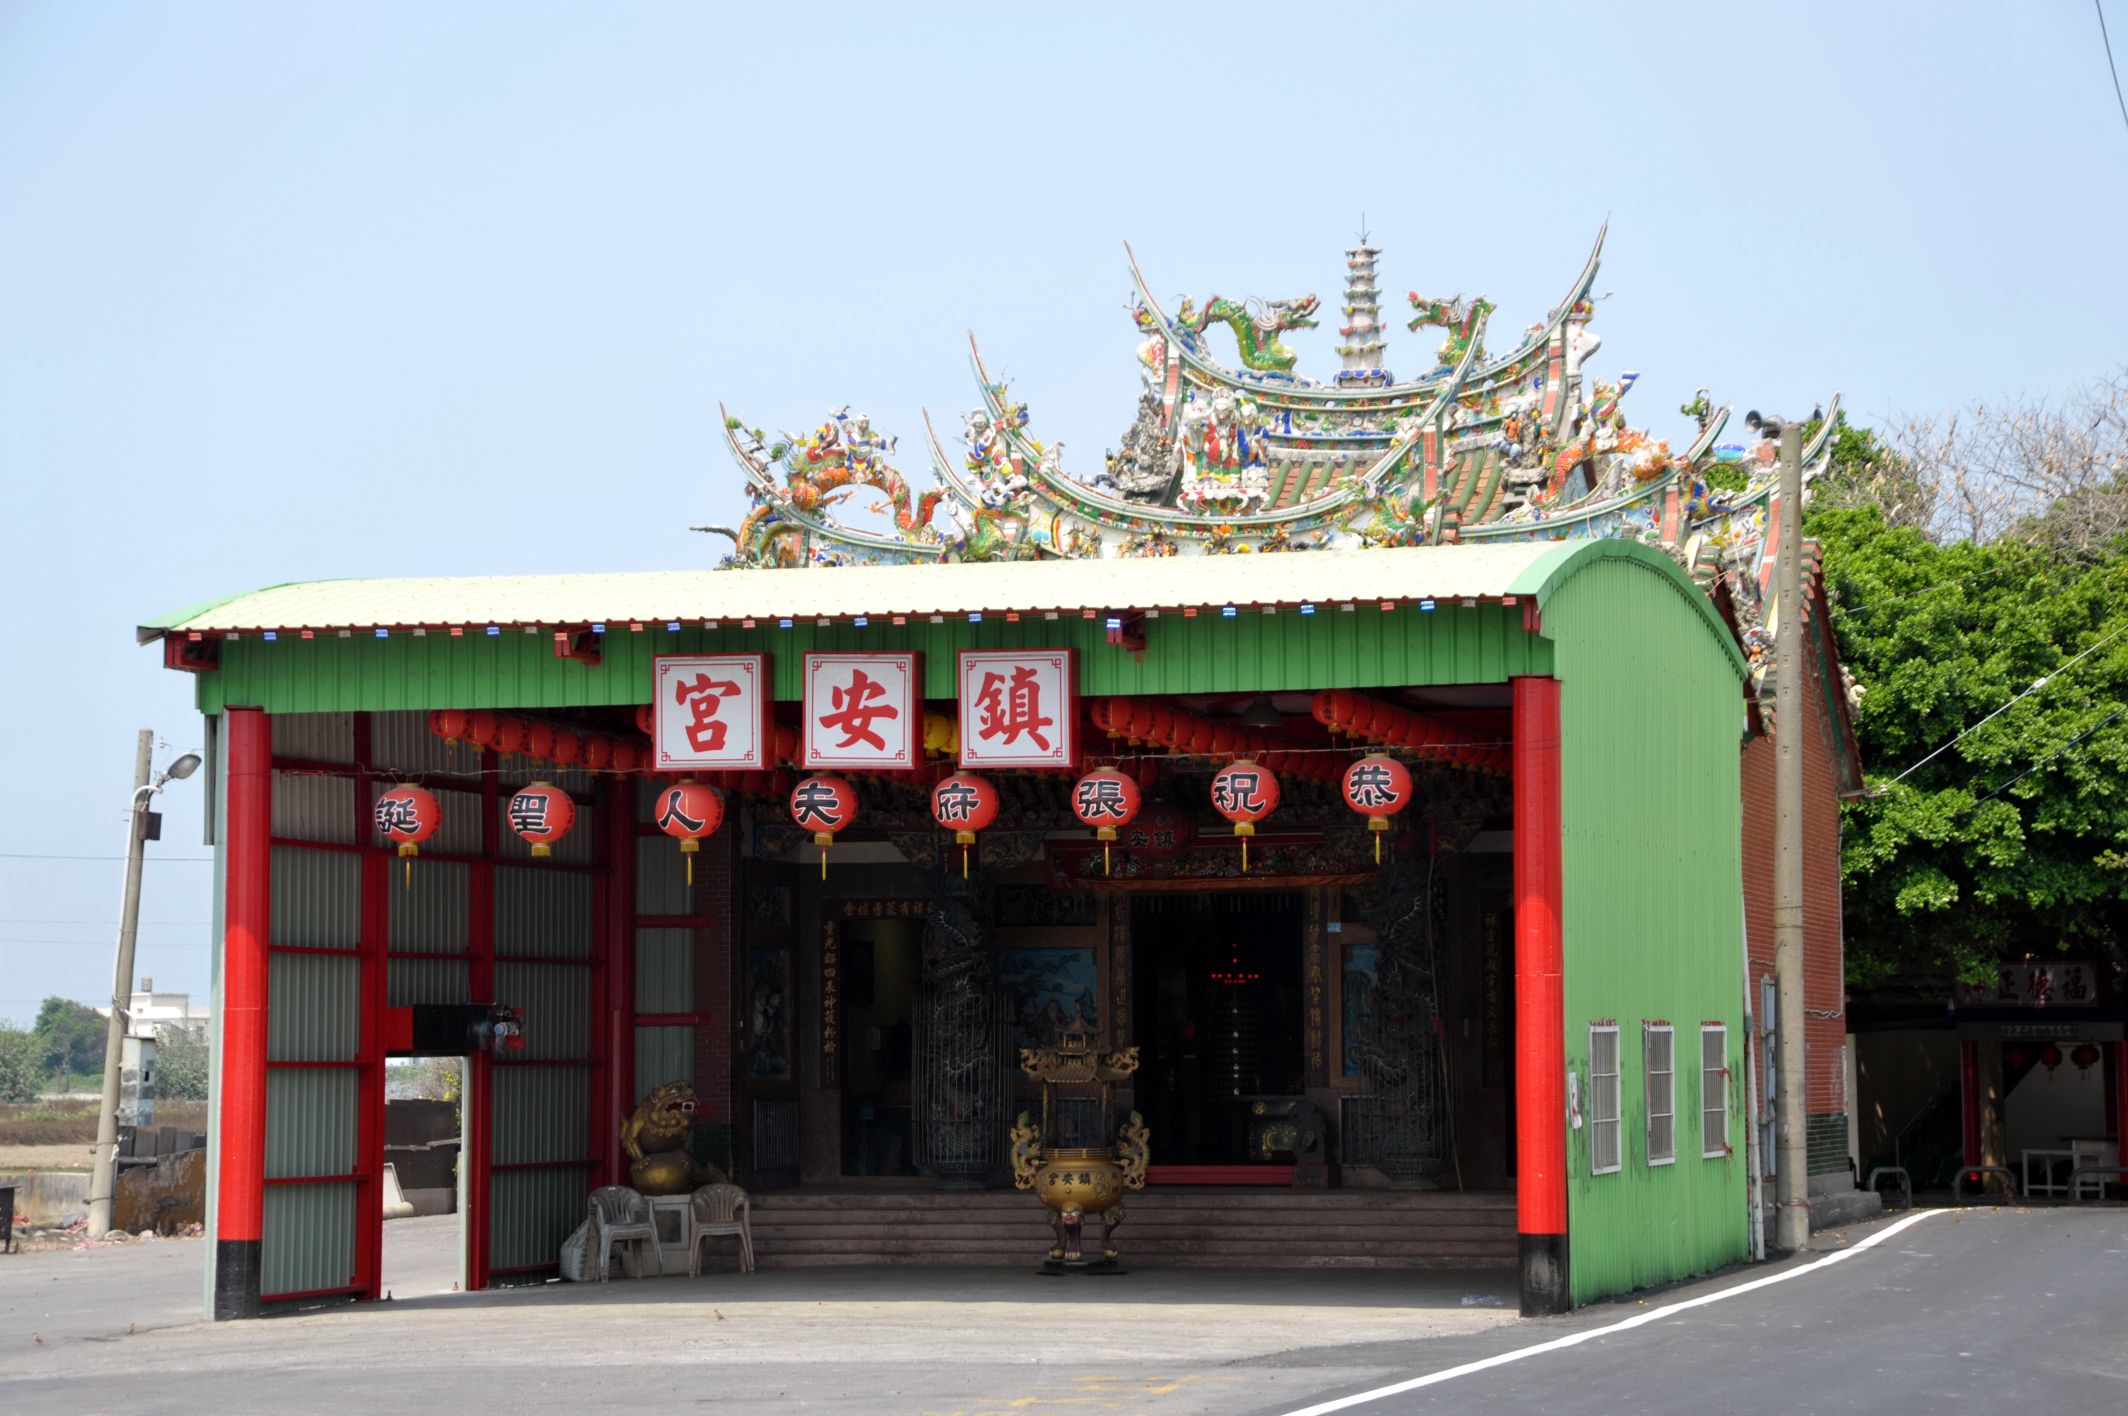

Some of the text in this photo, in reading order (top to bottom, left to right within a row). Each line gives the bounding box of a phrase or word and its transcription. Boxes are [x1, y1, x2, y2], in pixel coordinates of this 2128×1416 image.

[675, 666, 1054, 753] 鎮 安 宮
[374, 765, 1399, 835] 恭 祝 張 府 夫 人 聖 誕
[1963, 967, 2088, 1002] 福德正
